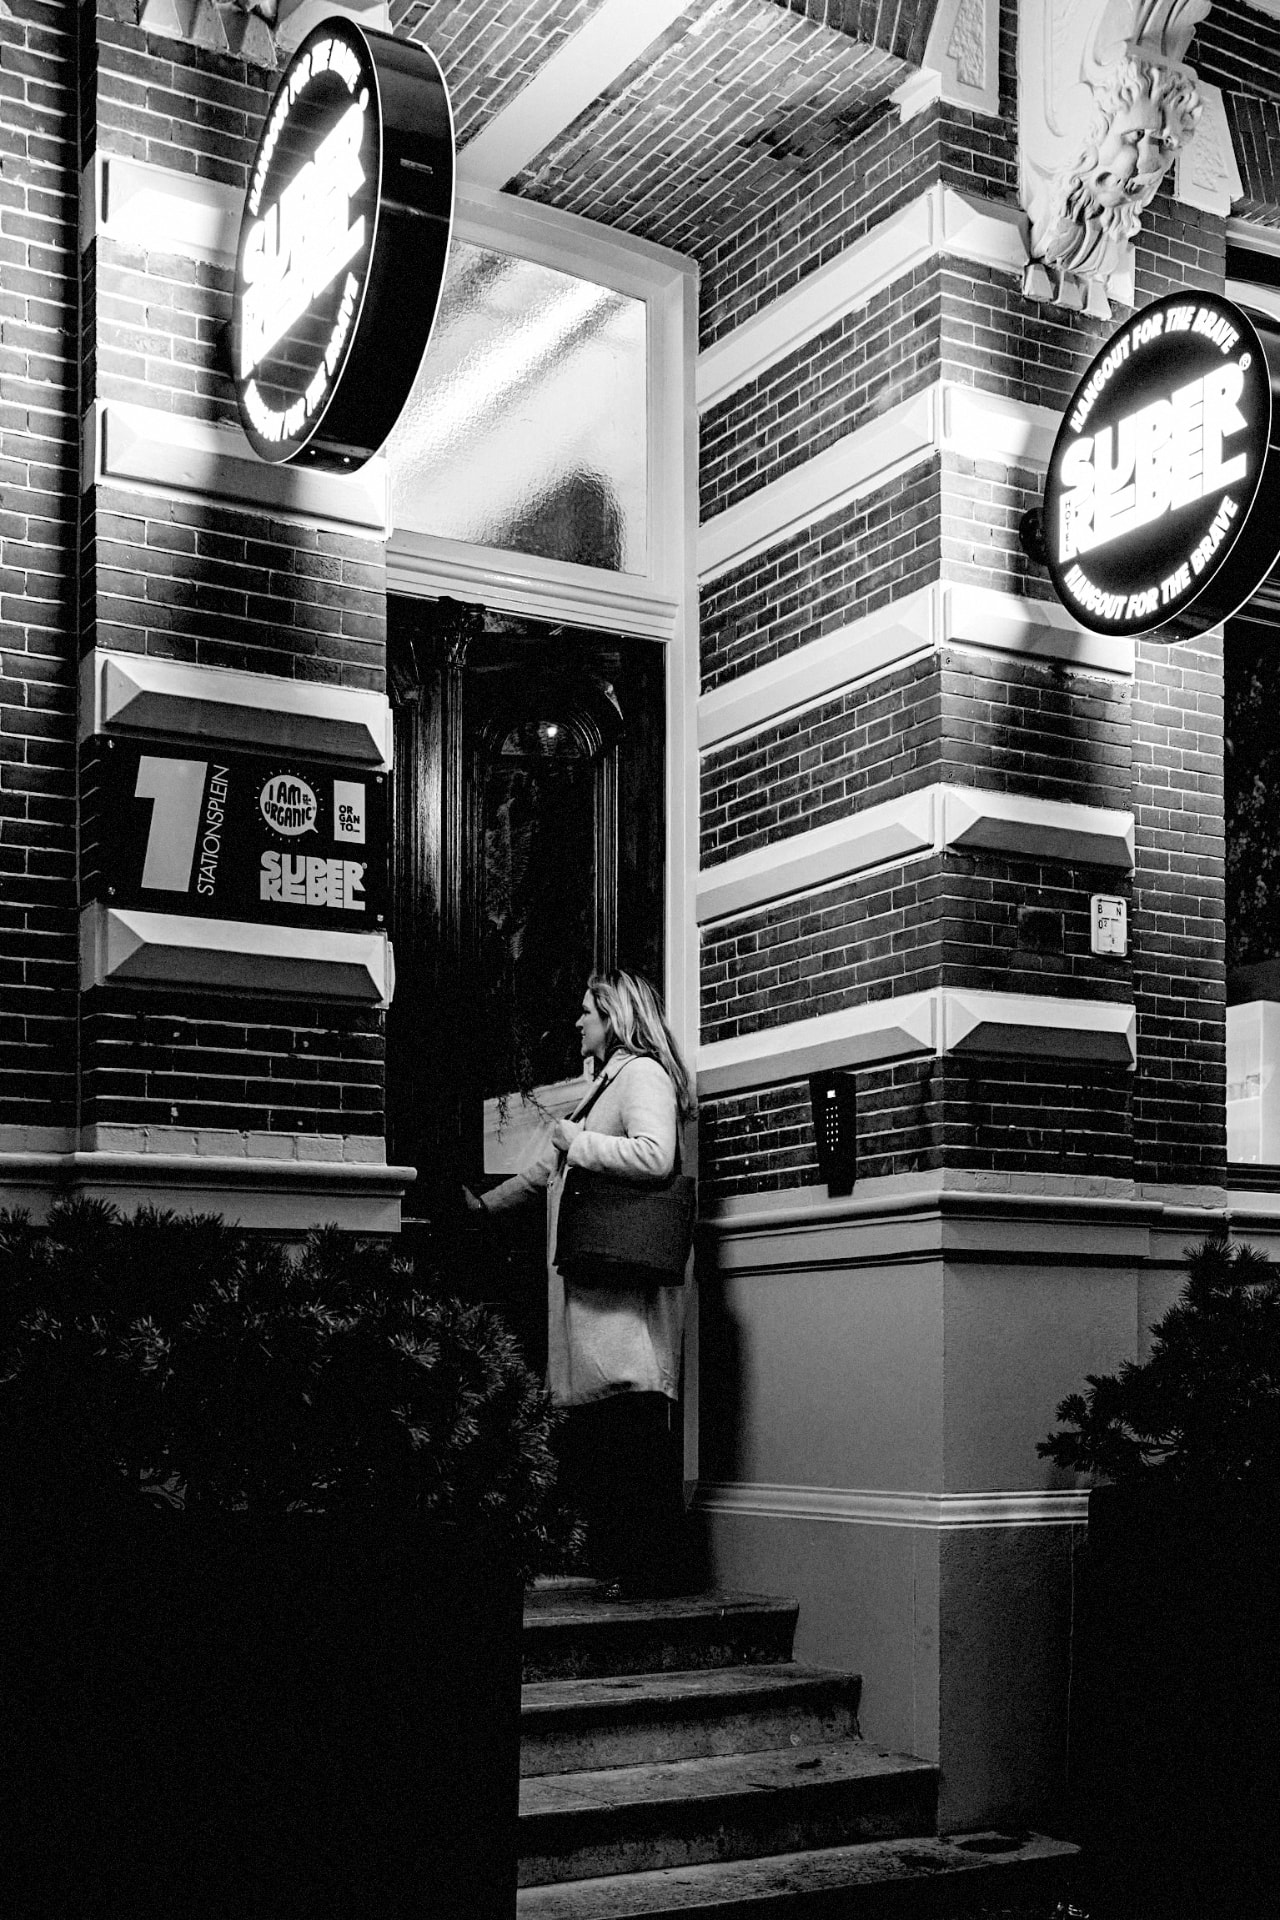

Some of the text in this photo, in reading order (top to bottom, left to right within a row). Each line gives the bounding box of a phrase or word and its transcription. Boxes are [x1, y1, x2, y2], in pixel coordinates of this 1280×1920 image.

[1069, 306, 1240, 433] HANGOUT FOR THE BRAVE
[1063, 495, 1239, 620] HANGOUT FOR THE BRAVE
[134, 755, 208, 892] 1
[197, 764, 229, 896] STATIONSPLEIN
[264, 801, 313, 828] ORGANIC
[269, 784, 274, 801] I
[276, 781, 301, 806] AM
[338, 804, 353, 815] OR
[338, 814, 360, 825] GAN
